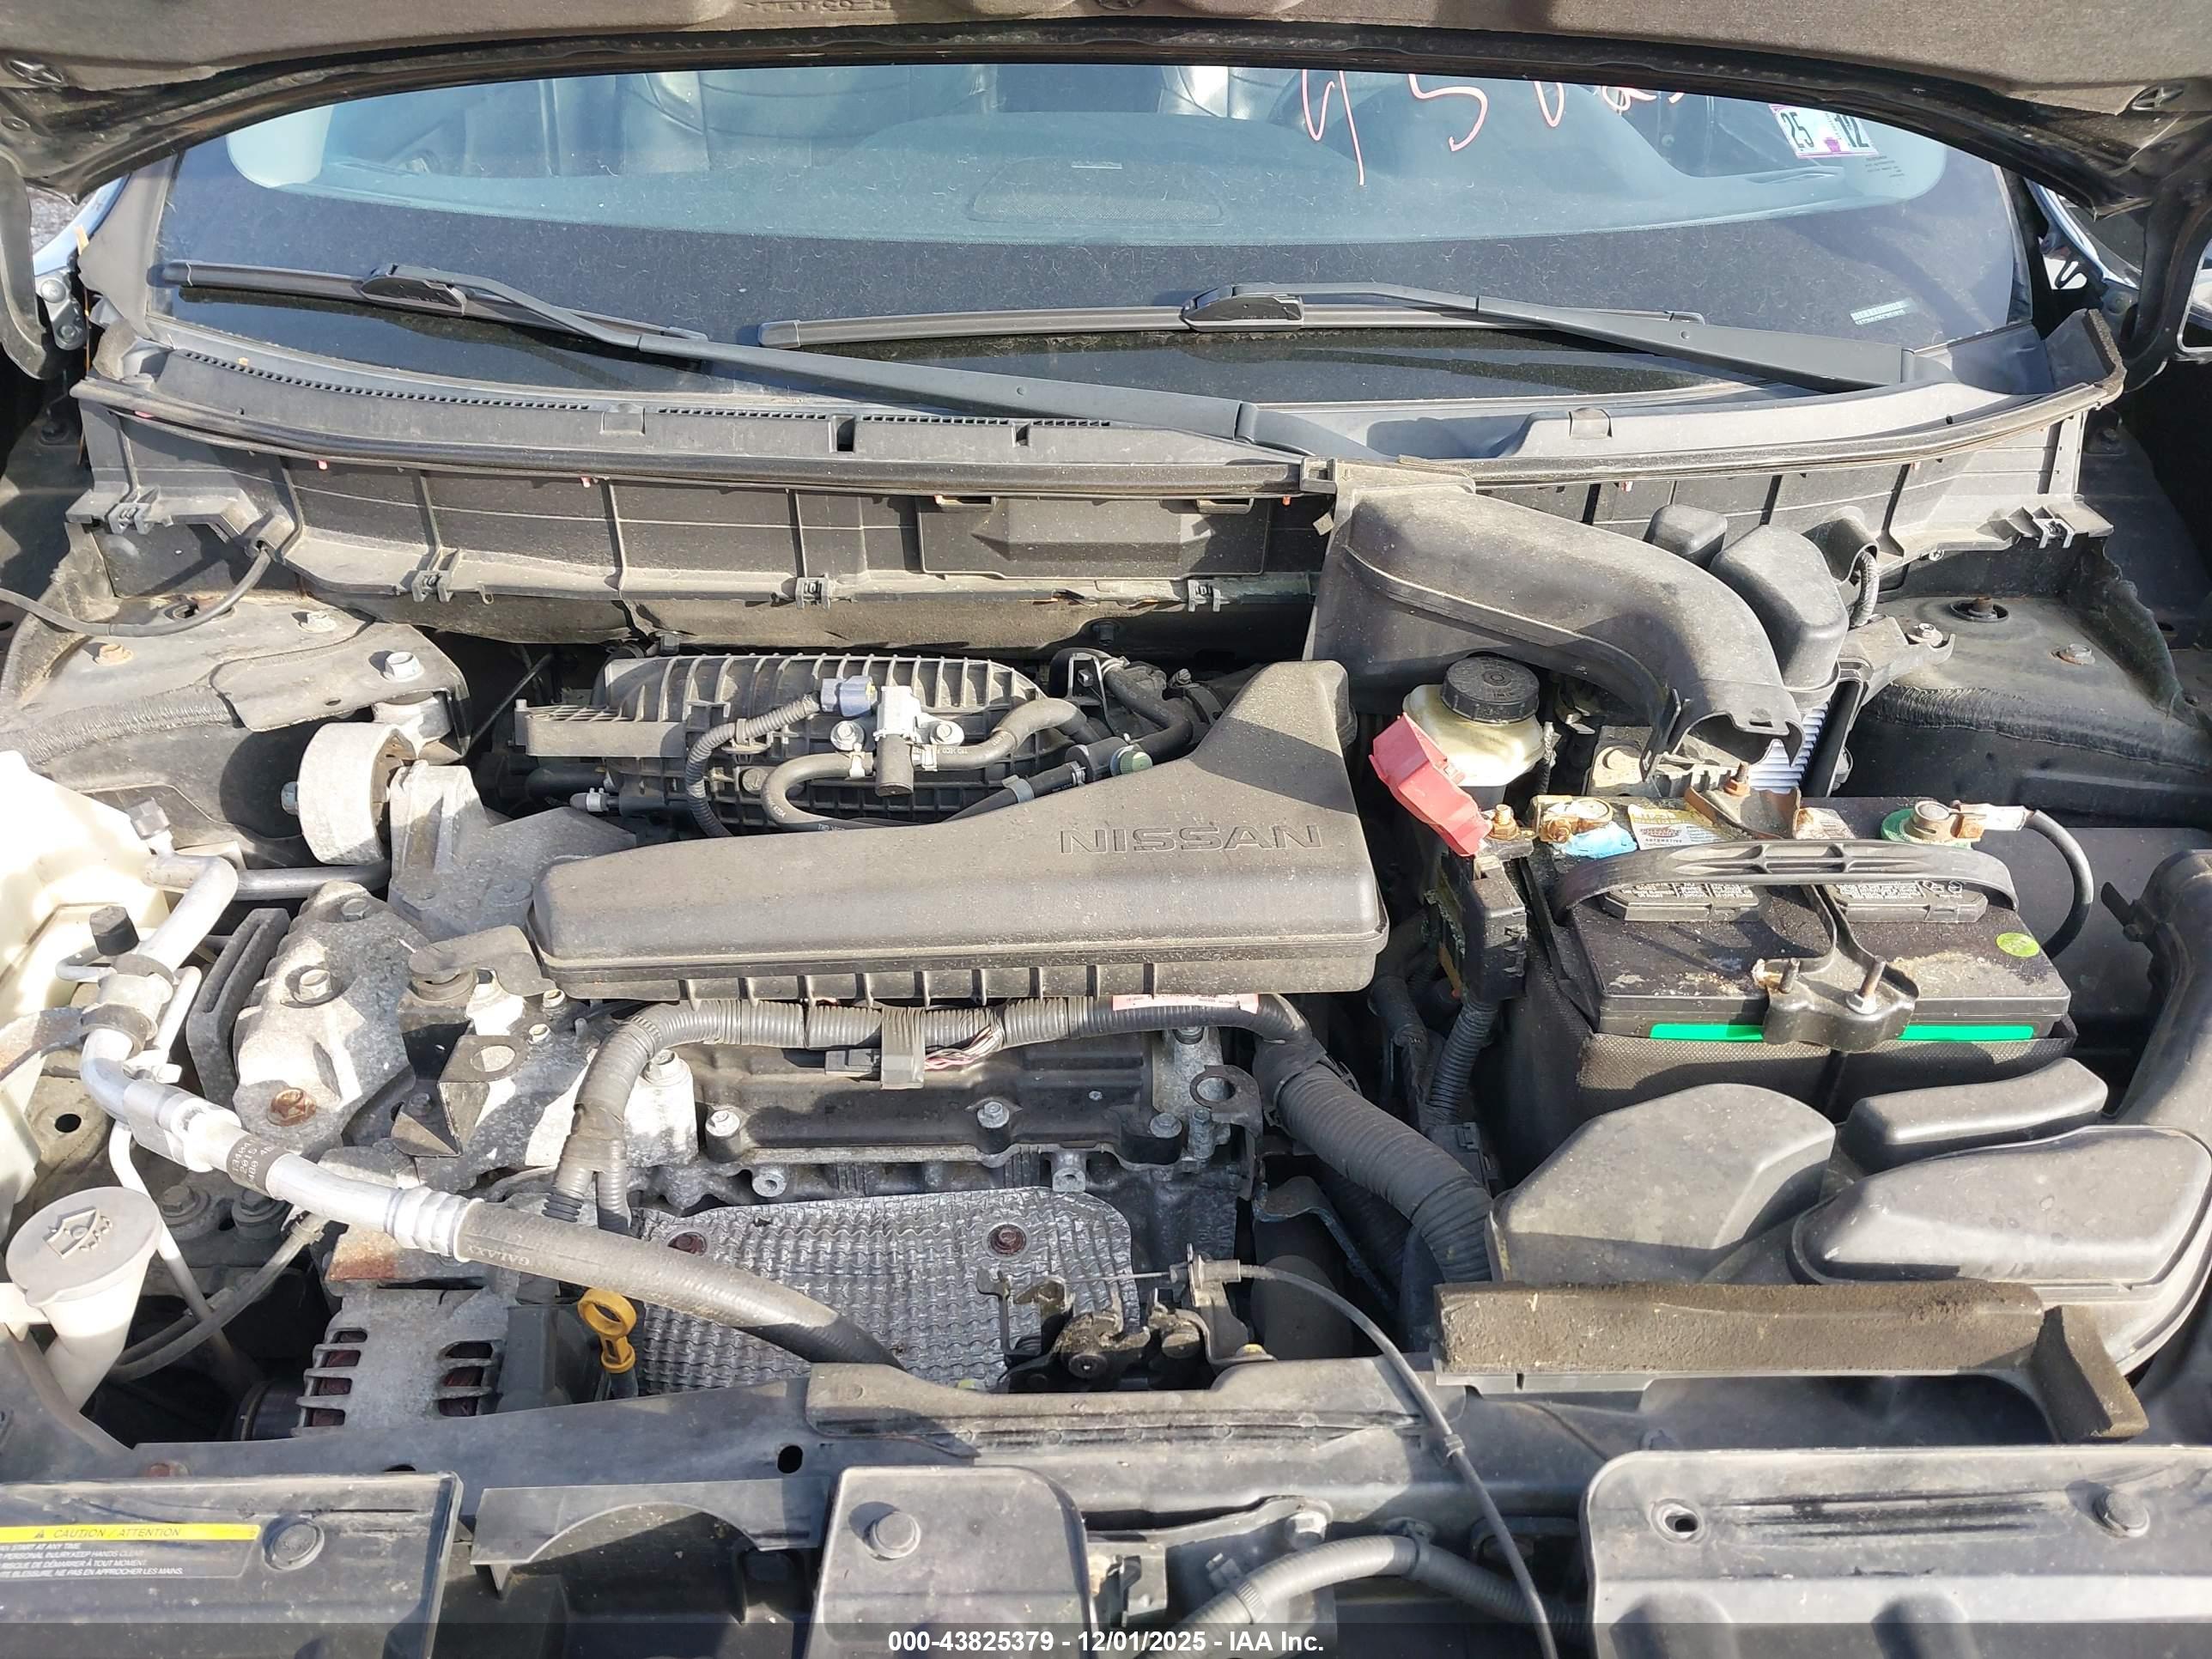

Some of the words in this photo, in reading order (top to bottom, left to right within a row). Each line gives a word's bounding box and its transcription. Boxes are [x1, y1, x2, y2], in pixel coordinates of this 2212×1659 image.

[1780, 112, 1814, 149] 25
[1834, 112, 1869, 149] 12
[1060, 825, 1322, 854] NISSAN
[467, 1244, 530, 1266] GALAXY
[53, 1528, 106, 1539] CAUTION
[118, 1528, 180, 1537] ATTENTION
[3, 1552, 44, 1560] PERSONAL
[67, 1568, 83, 1577] PAS
[94, 1567, 143, 1576] APPROCHER
